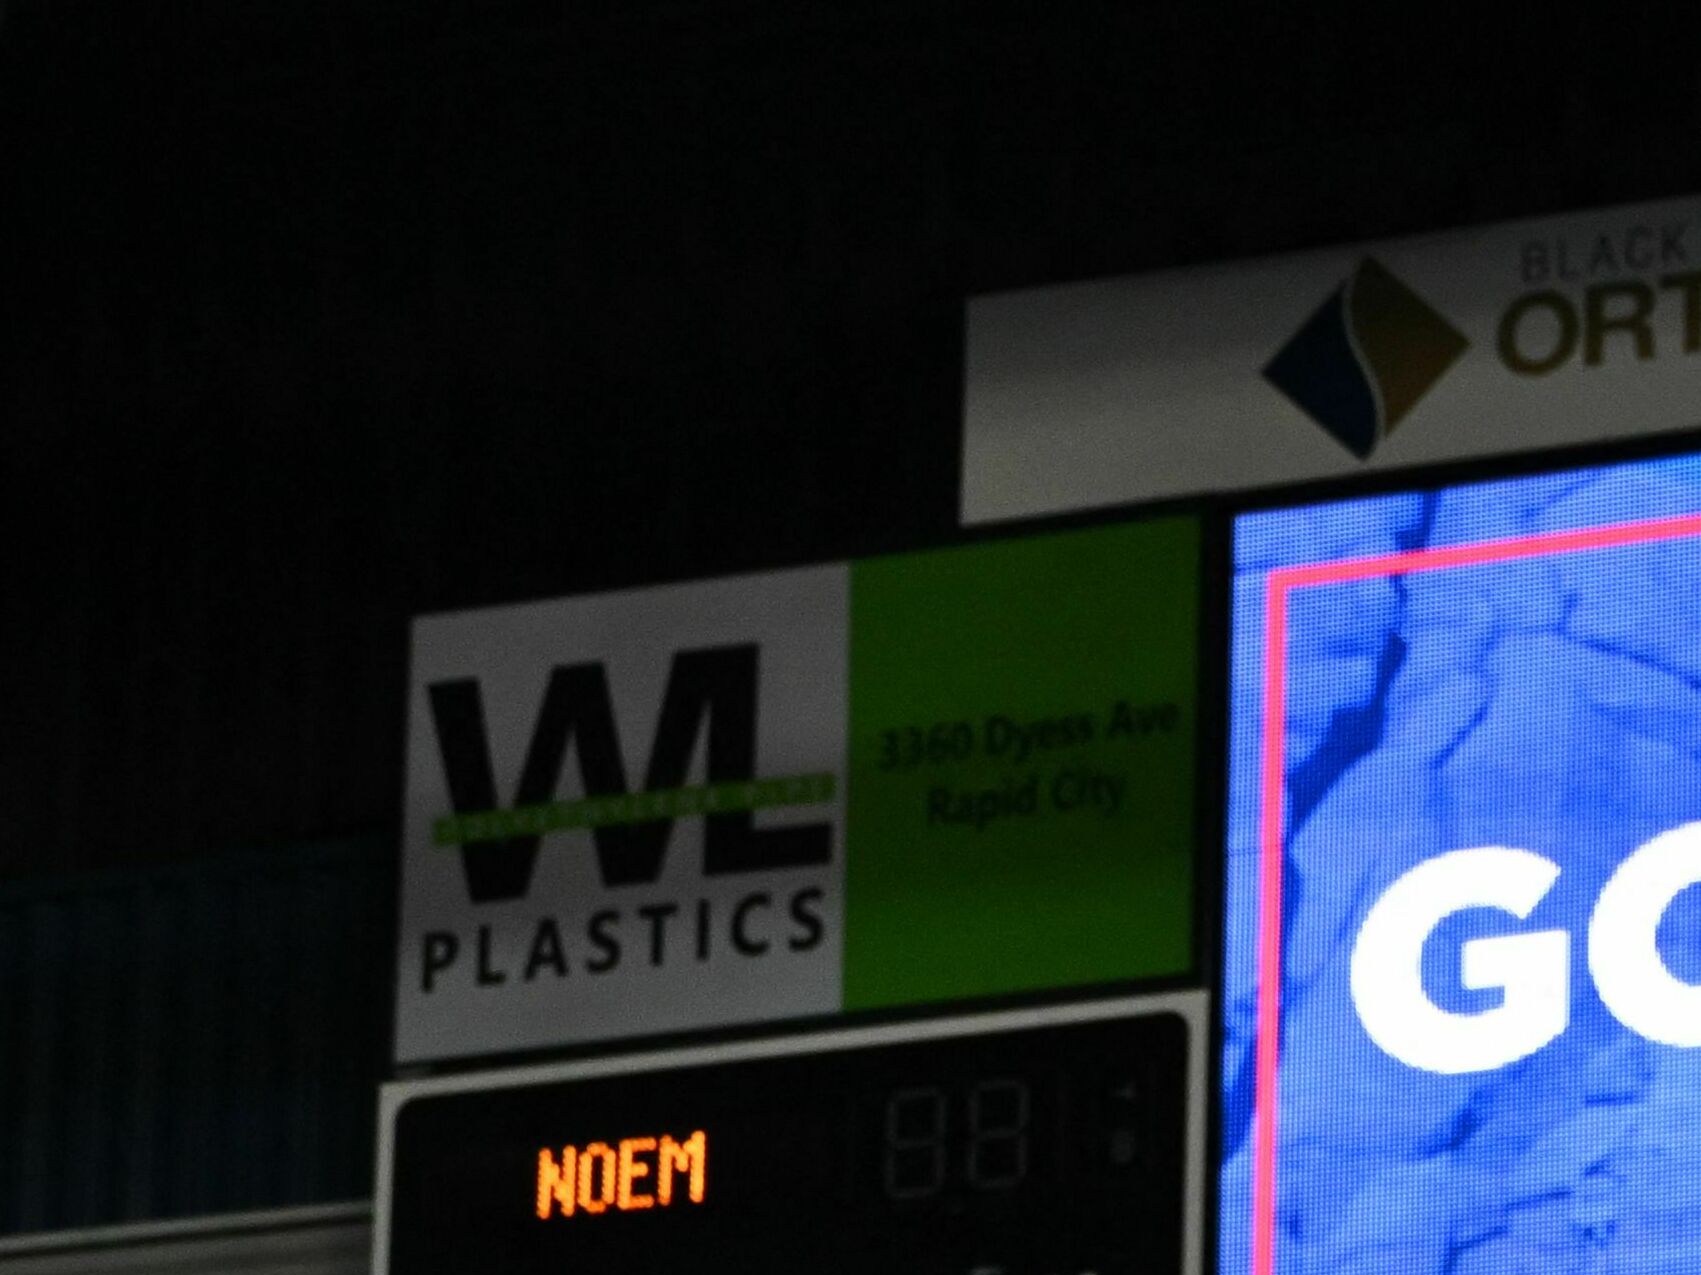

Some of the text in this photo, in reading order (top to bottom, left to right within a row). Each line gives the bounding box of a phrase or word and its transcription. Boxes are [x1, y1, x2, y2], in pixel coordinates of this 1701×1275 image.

[1521, 220, 1687, 285] BLACK
[1108, 697, 1180, 737] Ave
[926, 767, 1127, 834] Rapid City
[421, 886, 829, 996] PLASTICS
[537, 1131, 706, 1219] NOEM
